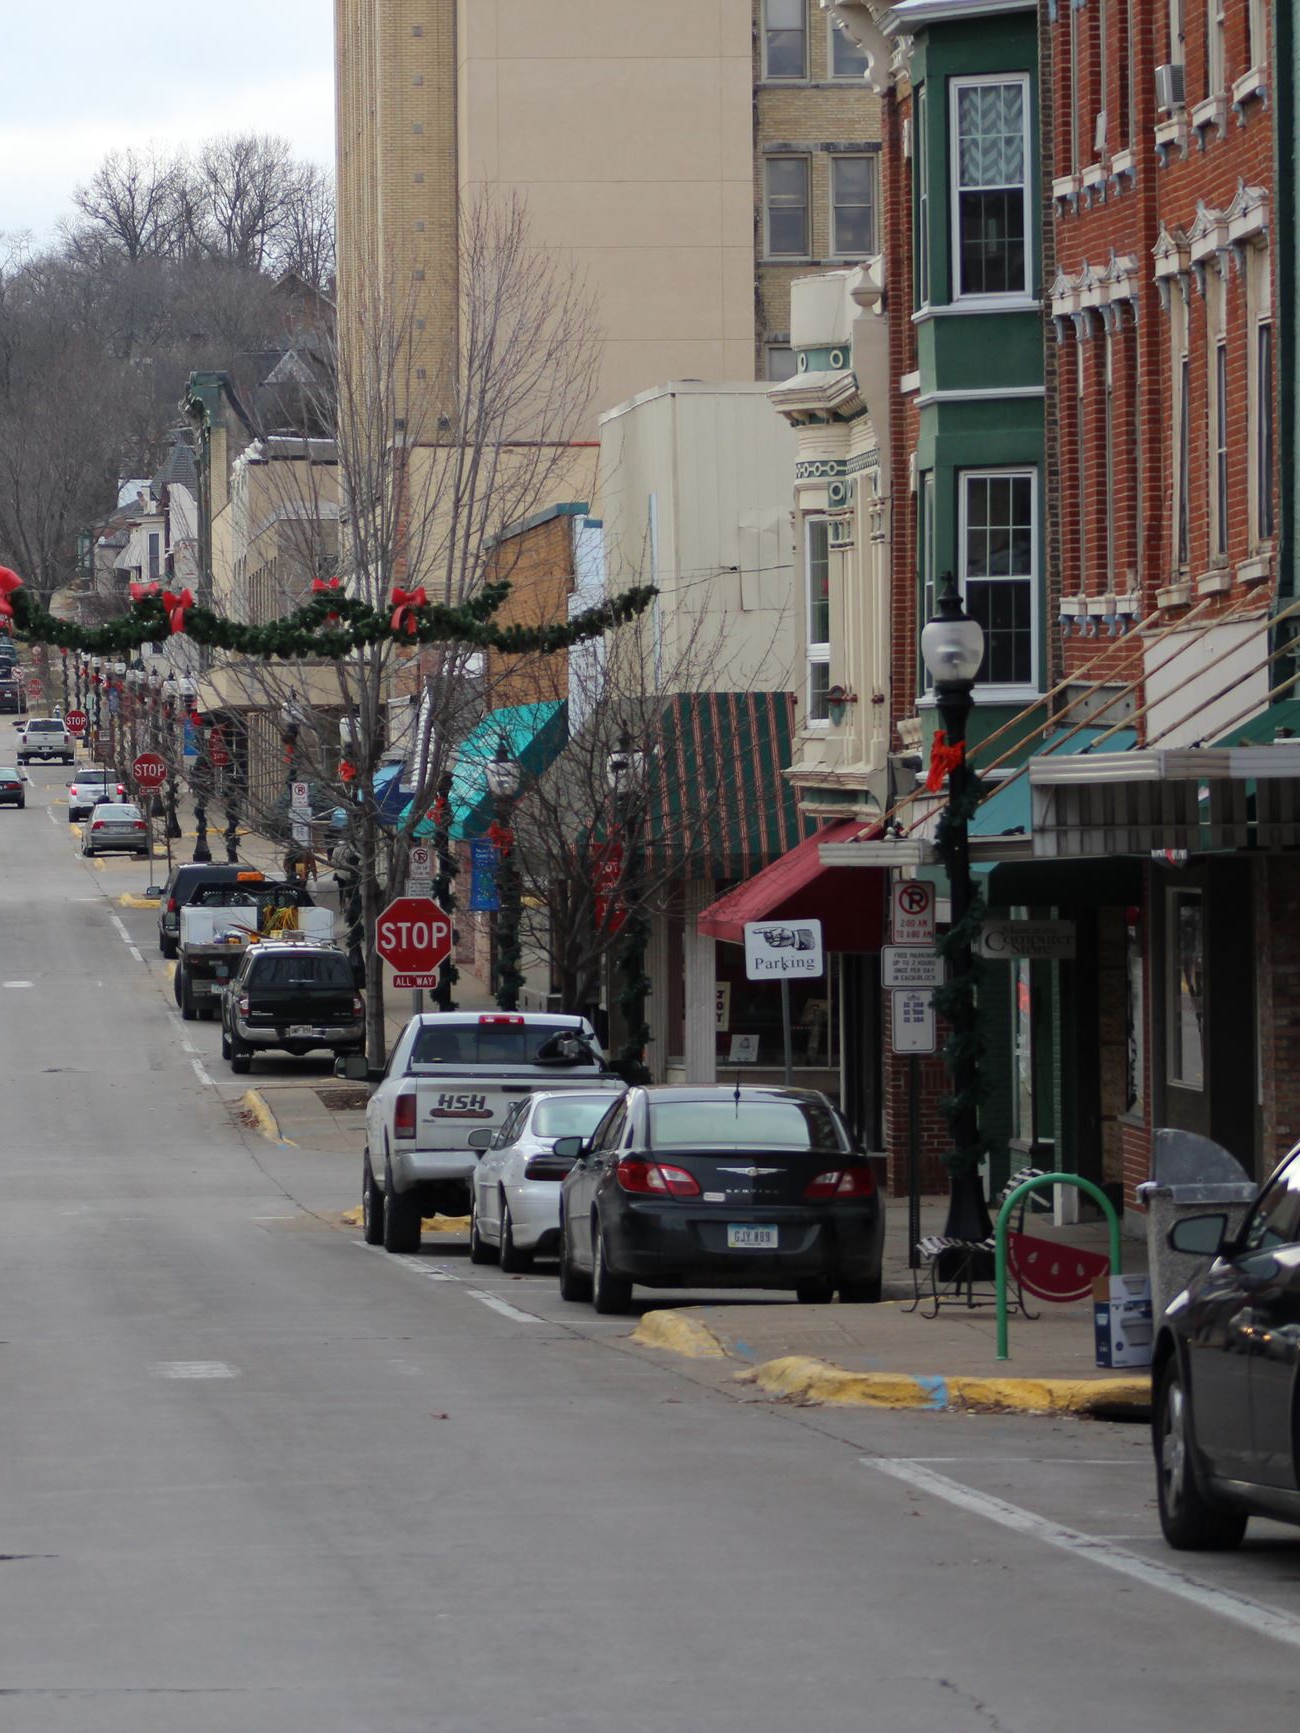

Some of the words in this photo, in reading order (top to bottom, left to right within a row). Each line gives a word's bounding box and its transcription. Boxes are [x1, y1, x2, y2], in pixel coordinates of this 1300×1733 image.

[66, 716, 86, 725] STOP
[134, 764, 166, 777] STOP
[900, 919, 915, 928] 2:00
[918, 919, 928, 927] AM
[381, 921, 448, 950] STOP
[896, 929, 904, 938] TO
[922, 929, 933, 938] AM
[755, 956, 815, 970] Parking
[395, 976, 412, 986] ALL
[416, 976, 433, 986] WAY
[437, 1093, 486, 1110] HSH
